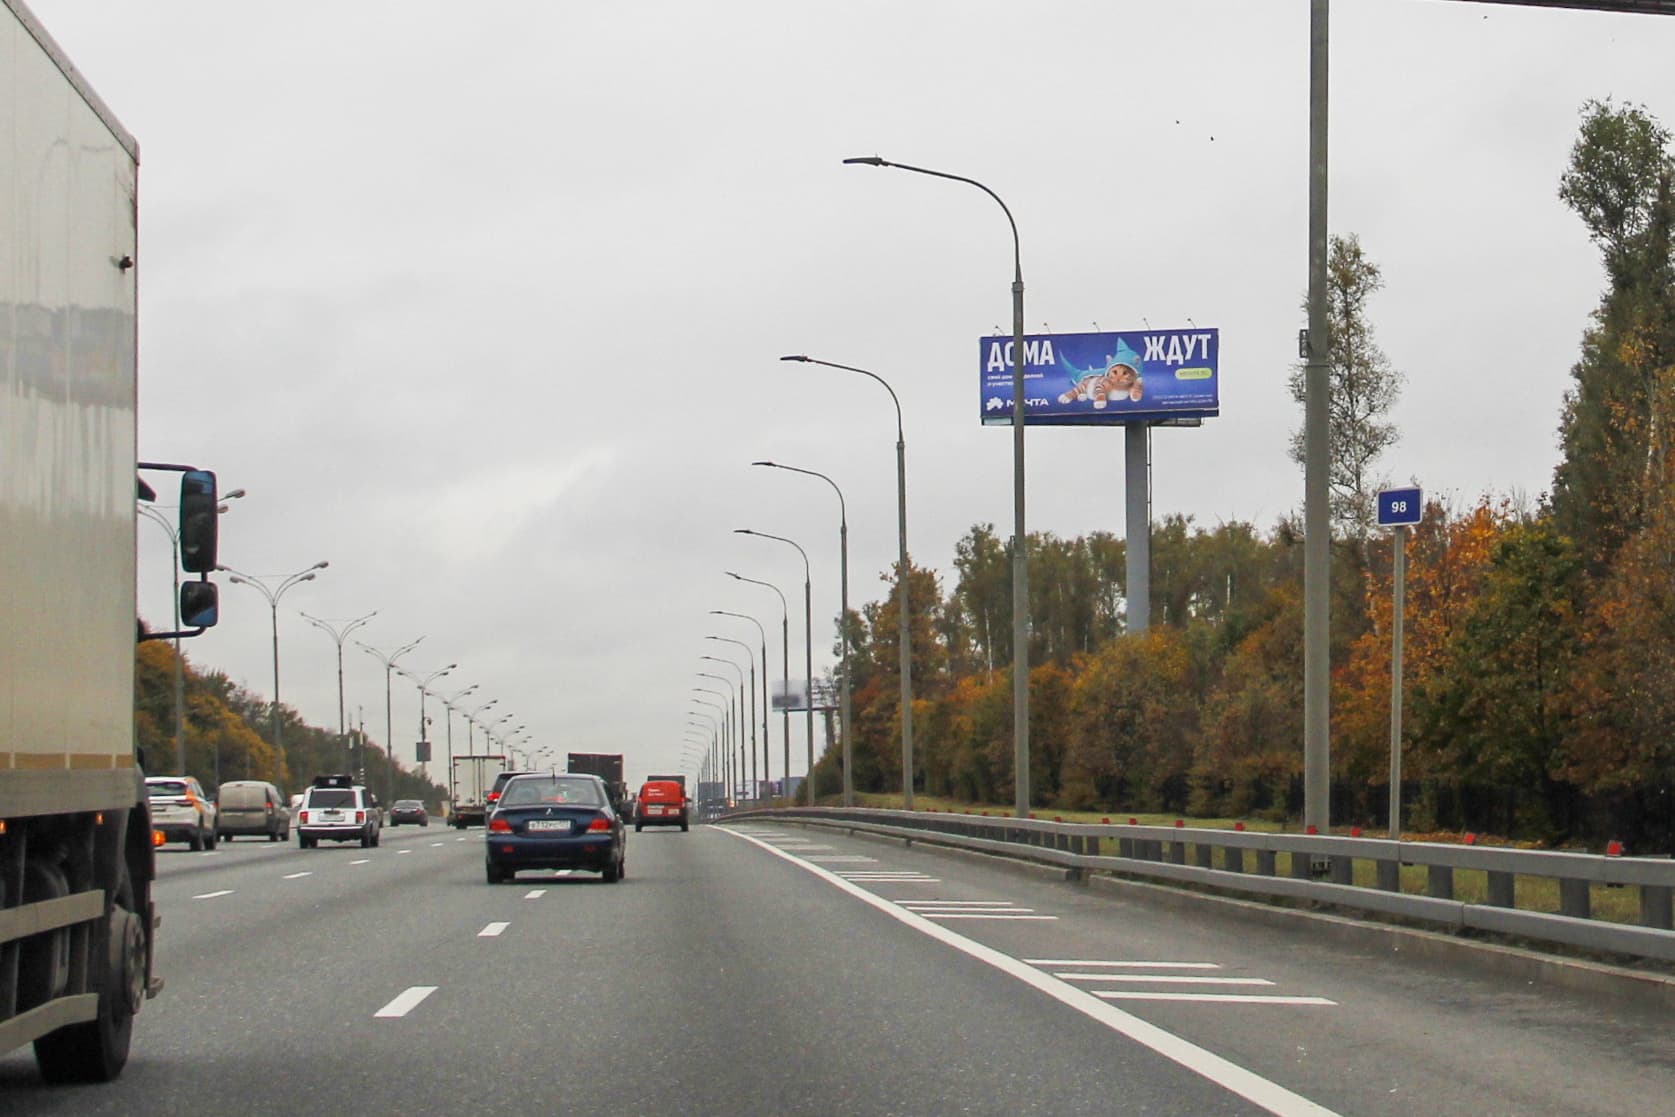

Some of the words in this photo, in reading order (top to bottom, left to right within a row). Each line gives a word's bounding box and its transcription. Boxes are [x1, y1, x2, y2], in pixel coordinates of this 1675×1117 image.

[987, 340, 1056, 372] ДОМА
[1143, 334, 1211, 366] ЖДУТ
[1006, 398, 1049, 408] МЧТА
[1391, 501, 1407, 513] 98
